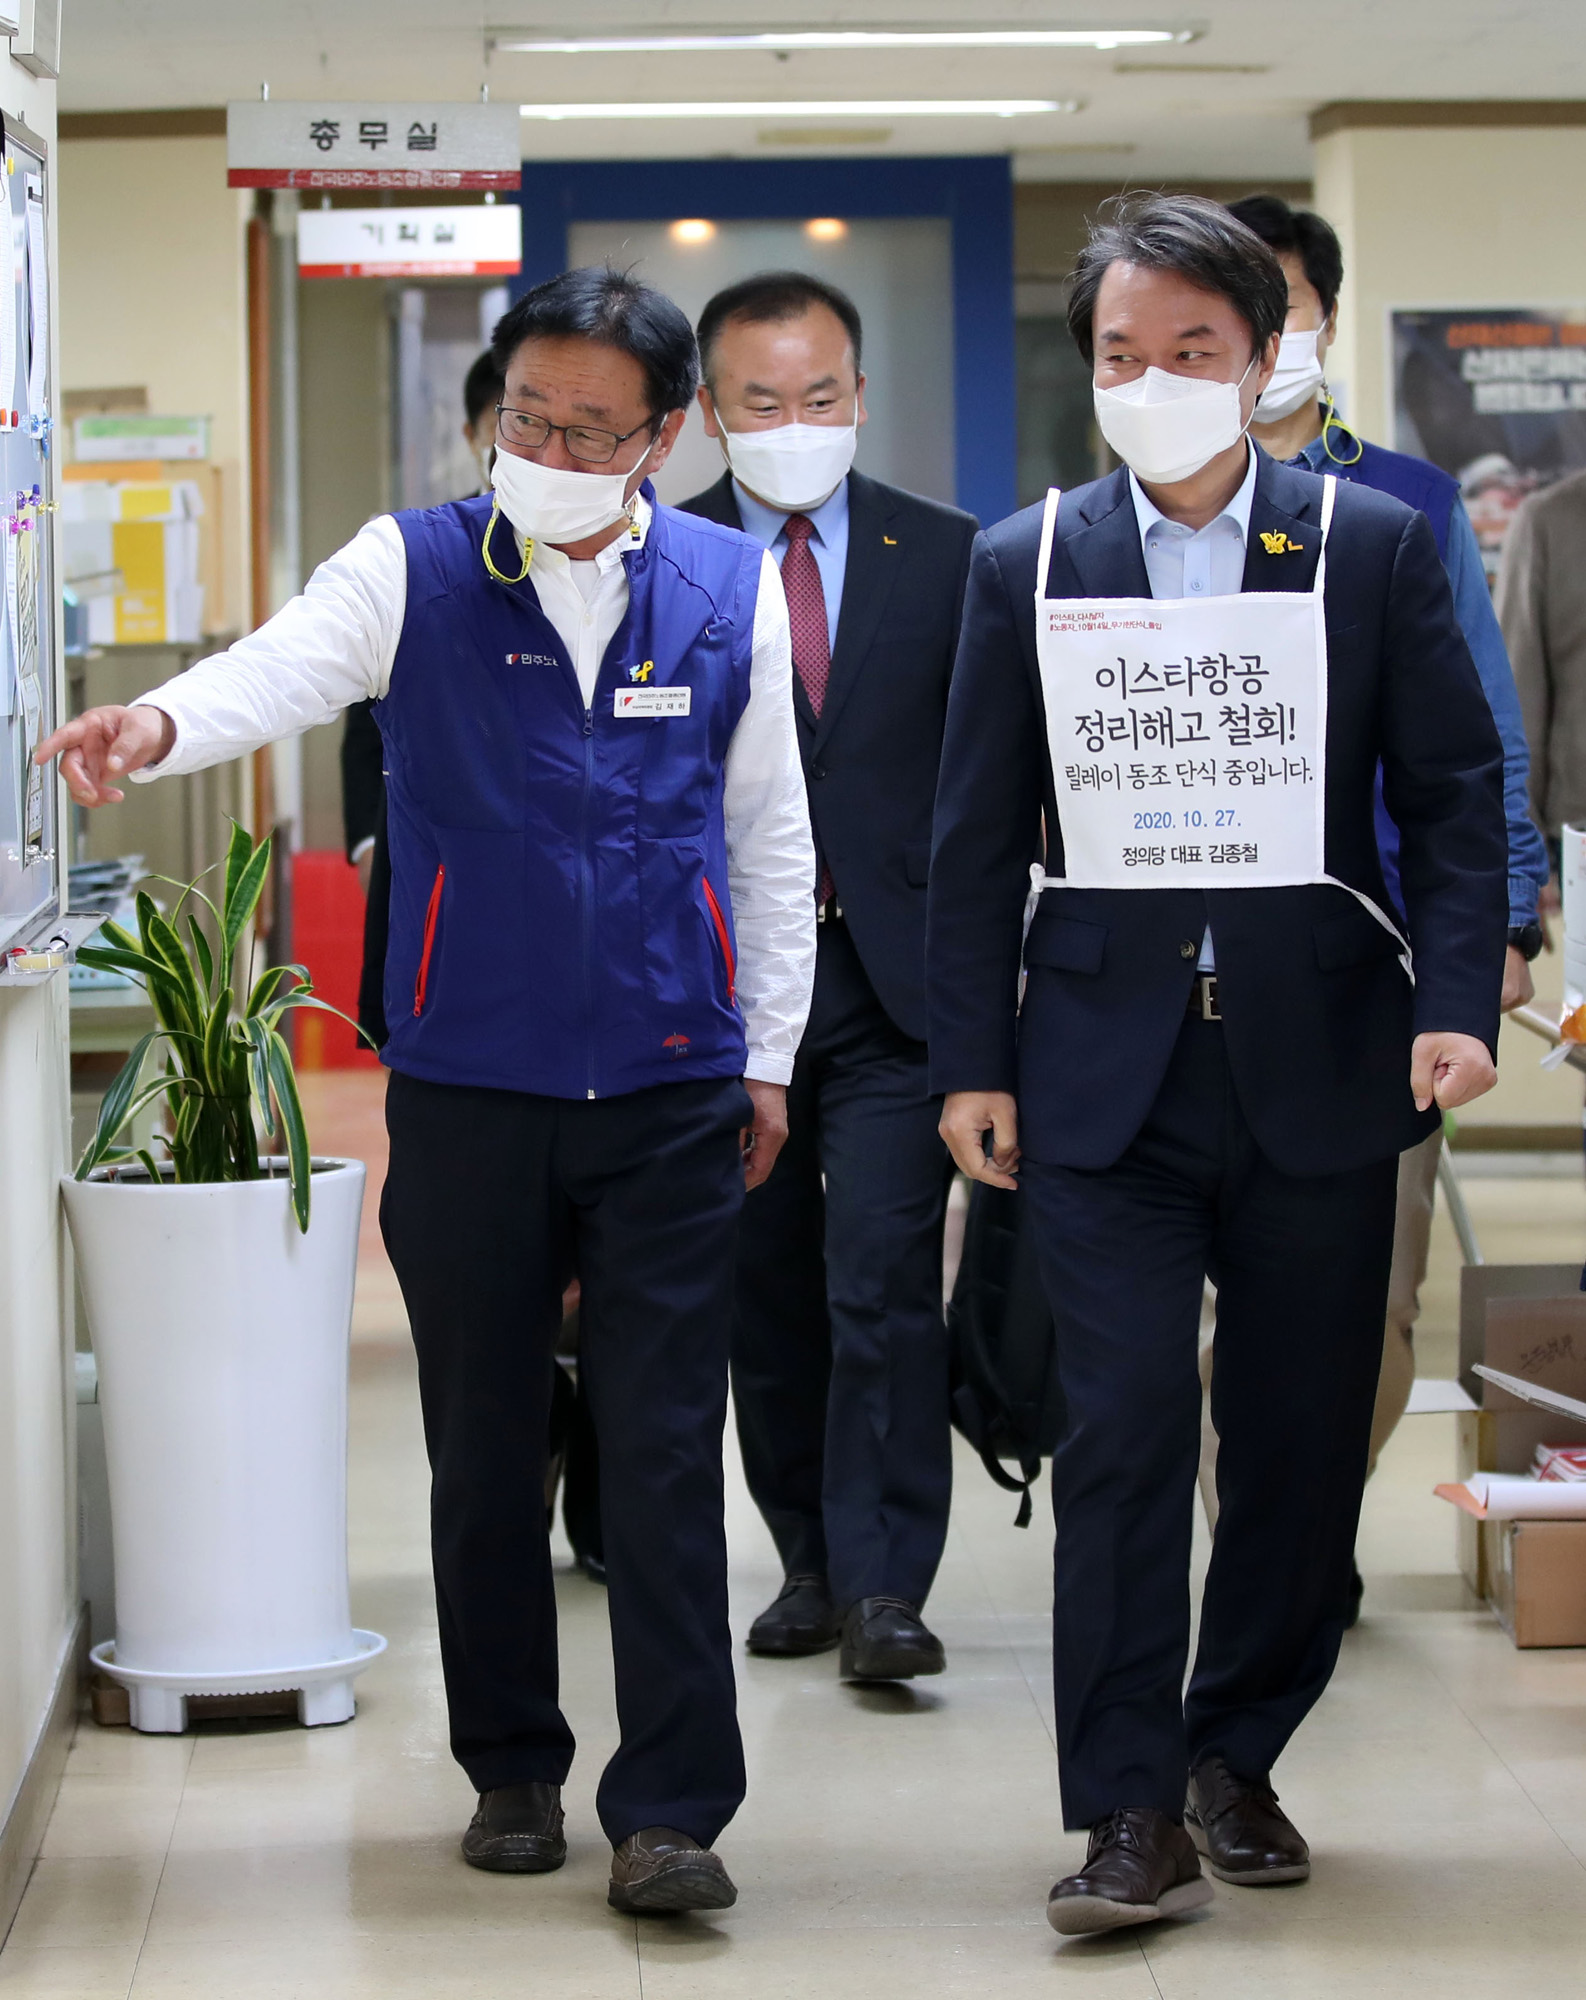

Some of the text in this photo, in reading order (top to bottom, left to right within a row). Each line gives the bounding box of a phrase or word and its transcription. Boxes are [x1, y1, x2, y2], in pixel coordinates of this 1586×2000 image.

[309, 119, 438, 151] 총무실
[1095, 652, 1270, 700] 이스타항공
[1074, 702, 1297, 753] 정리해고 철회!
[1065, 756, 1314, 791] 릴레이 동조 단식 중입니다.
[1133, 809, 1243, 830] 2020. 10. 27.
[1122, 843, 1259, 867] 정의당 대표 김종철
